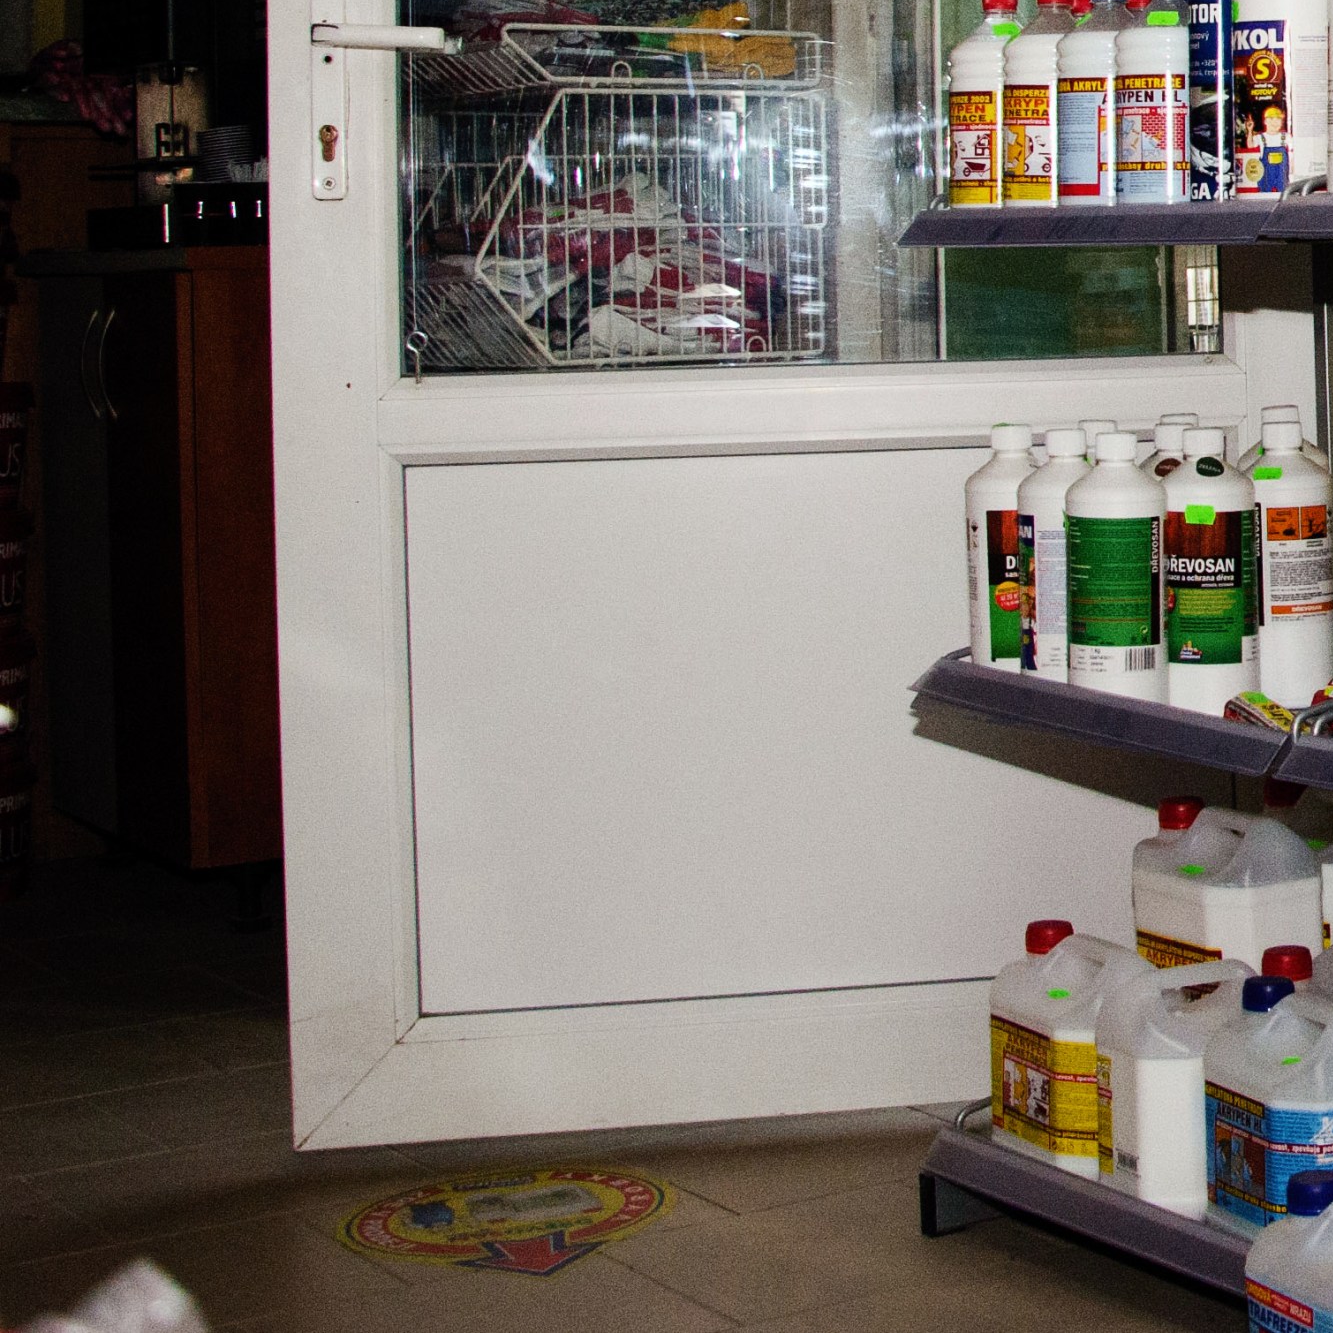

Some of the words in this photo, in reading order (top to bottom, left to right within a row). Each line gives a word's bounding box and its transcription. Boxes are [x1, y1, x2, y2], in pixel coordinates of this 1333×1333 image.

[1254, 57, 1271, 79] S
[1150, 521, 1160, 574] DŘEVOSAN
[1187, 574, 1216, 582] ochrana
[1217, 573, 1235, 581] dřeva
